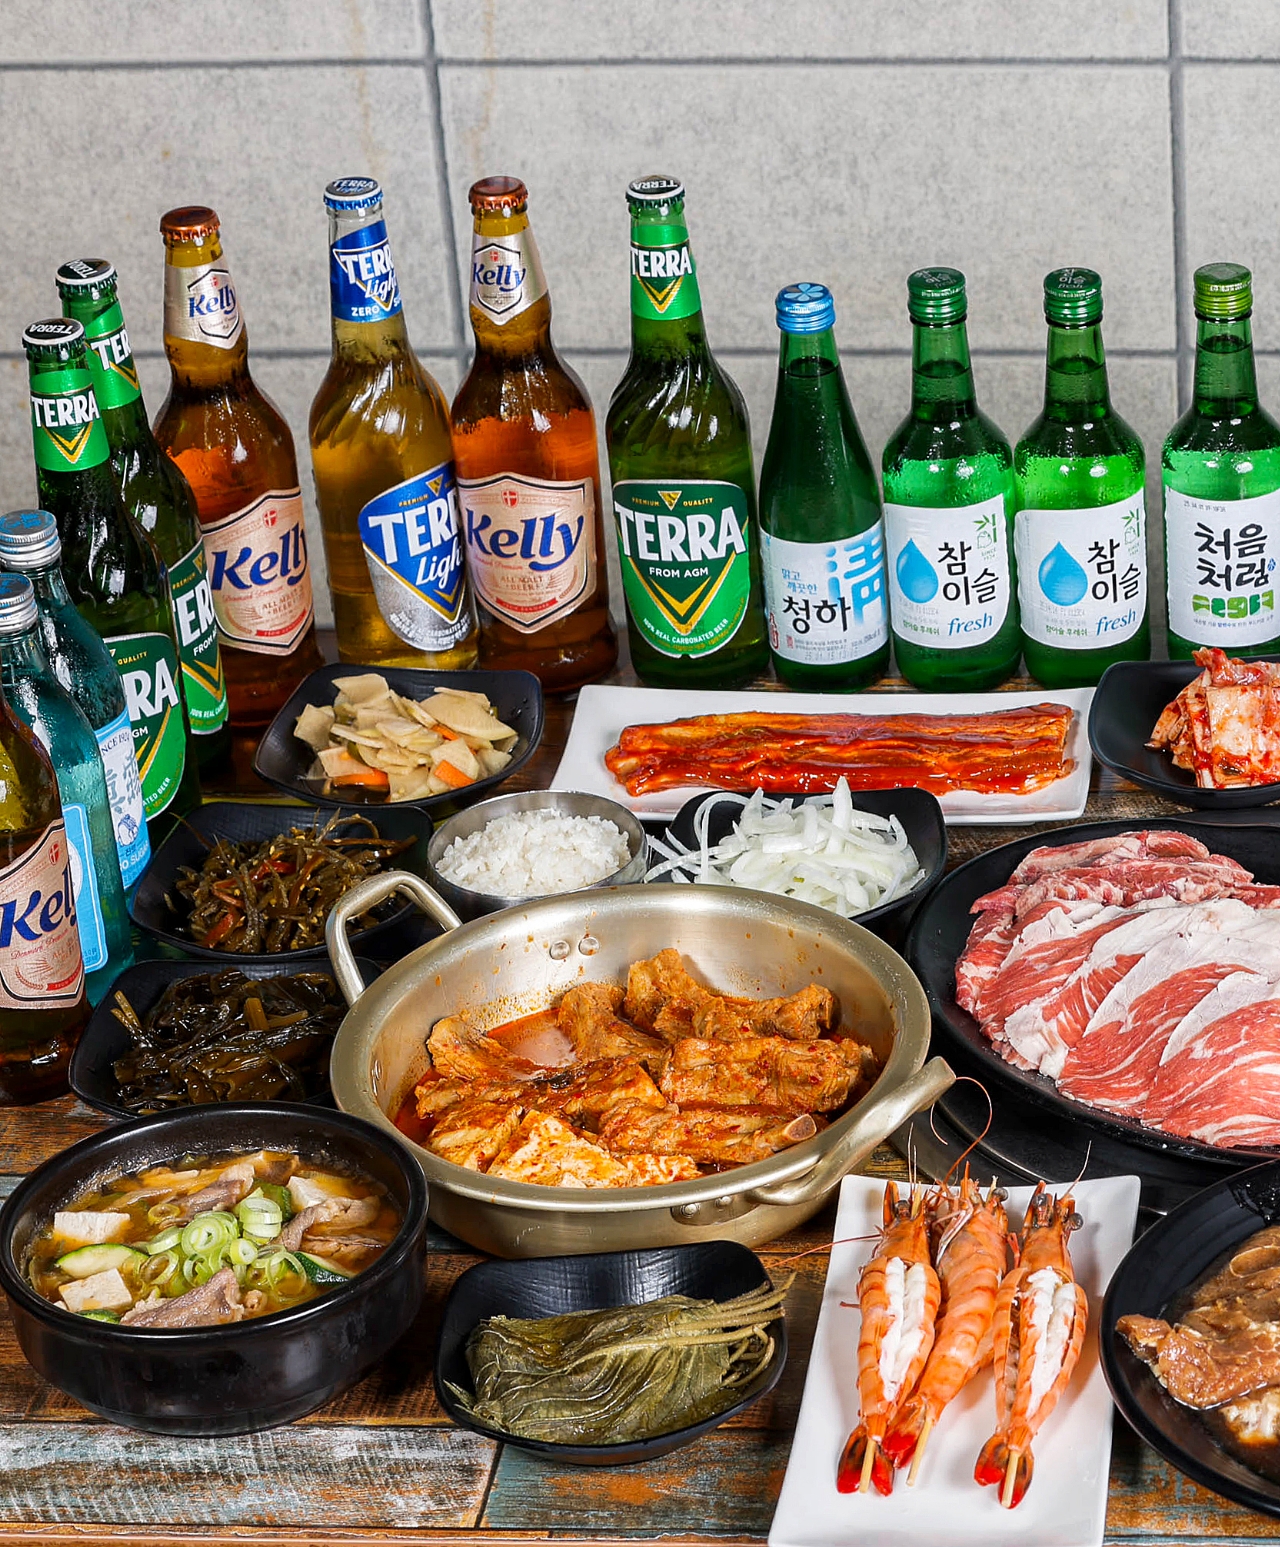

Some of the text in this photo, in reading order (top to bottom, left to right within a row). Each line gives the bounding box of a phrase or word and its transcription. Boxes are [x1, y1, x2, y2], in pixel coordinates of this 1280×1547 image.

[333, 179, 375, 189] TERRA
[632, 180, 678, 190] TERRA
[630, 246, 692, 277] TERRA
[473, 262, 526, 292] Kelly
[189, 284, 236, 318] Kelly
[351, 306, 379, 316] ZERO
[30, 324, 74, 334] TERRA
[31, 390, 100, 428] TERRA
[398, 494, 428, 507] PREMIUM
[632, 498, 714, 507] PREMIUM QUALITY
[466, 507, 584, 571] Kelly
[614, 501, 746, 562] TERRA
[1194, 522, 1267, 561] 처음
[211, 522, 308, 591] Kelly
[416, 536, 463, 589] Ligh
[938, 541, 972, 576] 참
[1087, 539, 1120, 575] 참
[172, 572, 197, 589] PREMIUM
[649, 567, 709, 578] FROM AGM
[942, 567, 999, 606] 이슬
[1092, 563, 1141, 604] 이슬
[1196, 557, 1269, 592] 처럼
[782, 595, 851, 634] 청하
[948, 612, 993, 636] fresh
[1096, 608, 1136, 636] fresh
[656, 629, 670, 641] REAL
[672, 631, 714, 644] CARBONATED
[714, 618, 729, 634] BEER
[118, 651, 147, 665] QUALITY
[193, 636, 213, 656] FROM
[131, 726, 148, 738] GM
[101, 737, 118, 757] NCE
[157, 777, 171, 796] BEER
